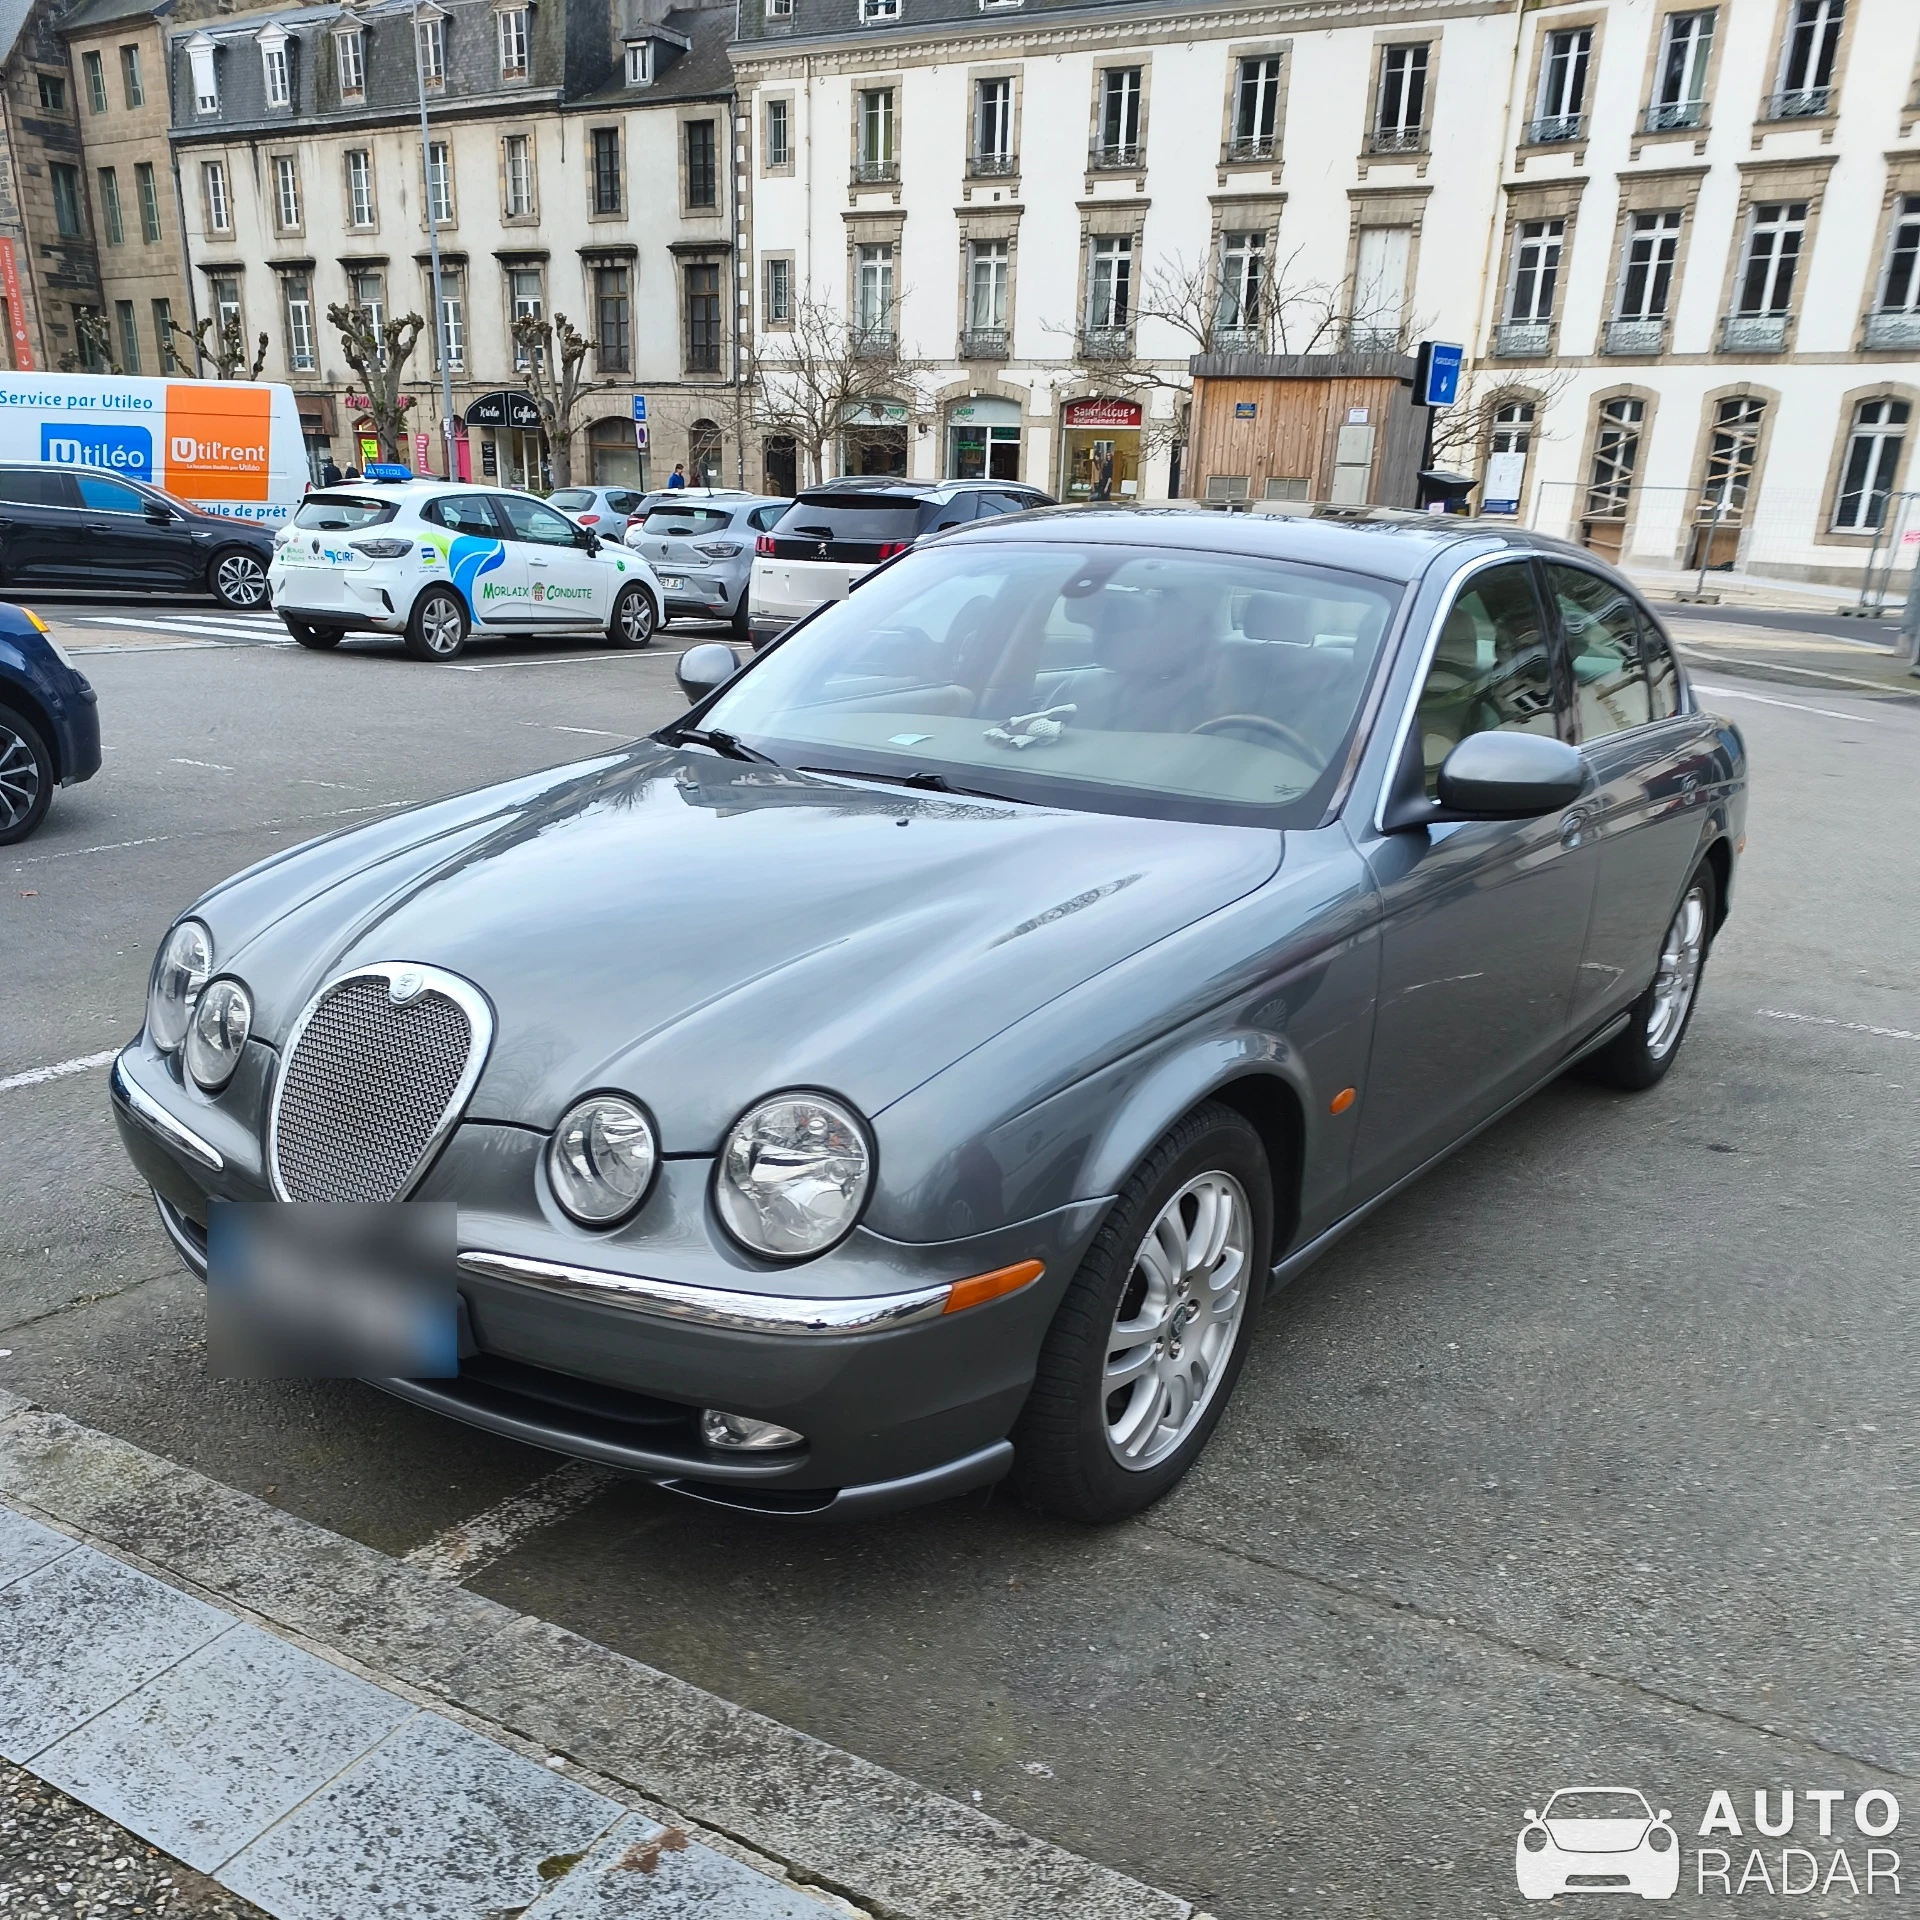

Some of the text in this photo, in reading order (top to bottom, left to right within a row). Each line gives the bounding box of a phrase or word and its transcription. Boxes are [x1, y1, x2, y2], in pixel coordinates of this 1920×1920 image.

[4, 246, 22, 327] Office de Tourisme
[0, 391, 153, 410] Service par Utileo
[49, 438, 145, 468] Utiléo
[235, 504, 252, 517] de
[257, 505, 287, 520] prêt
[483, 582, 593, 600] MORLAIX CONDUITE
